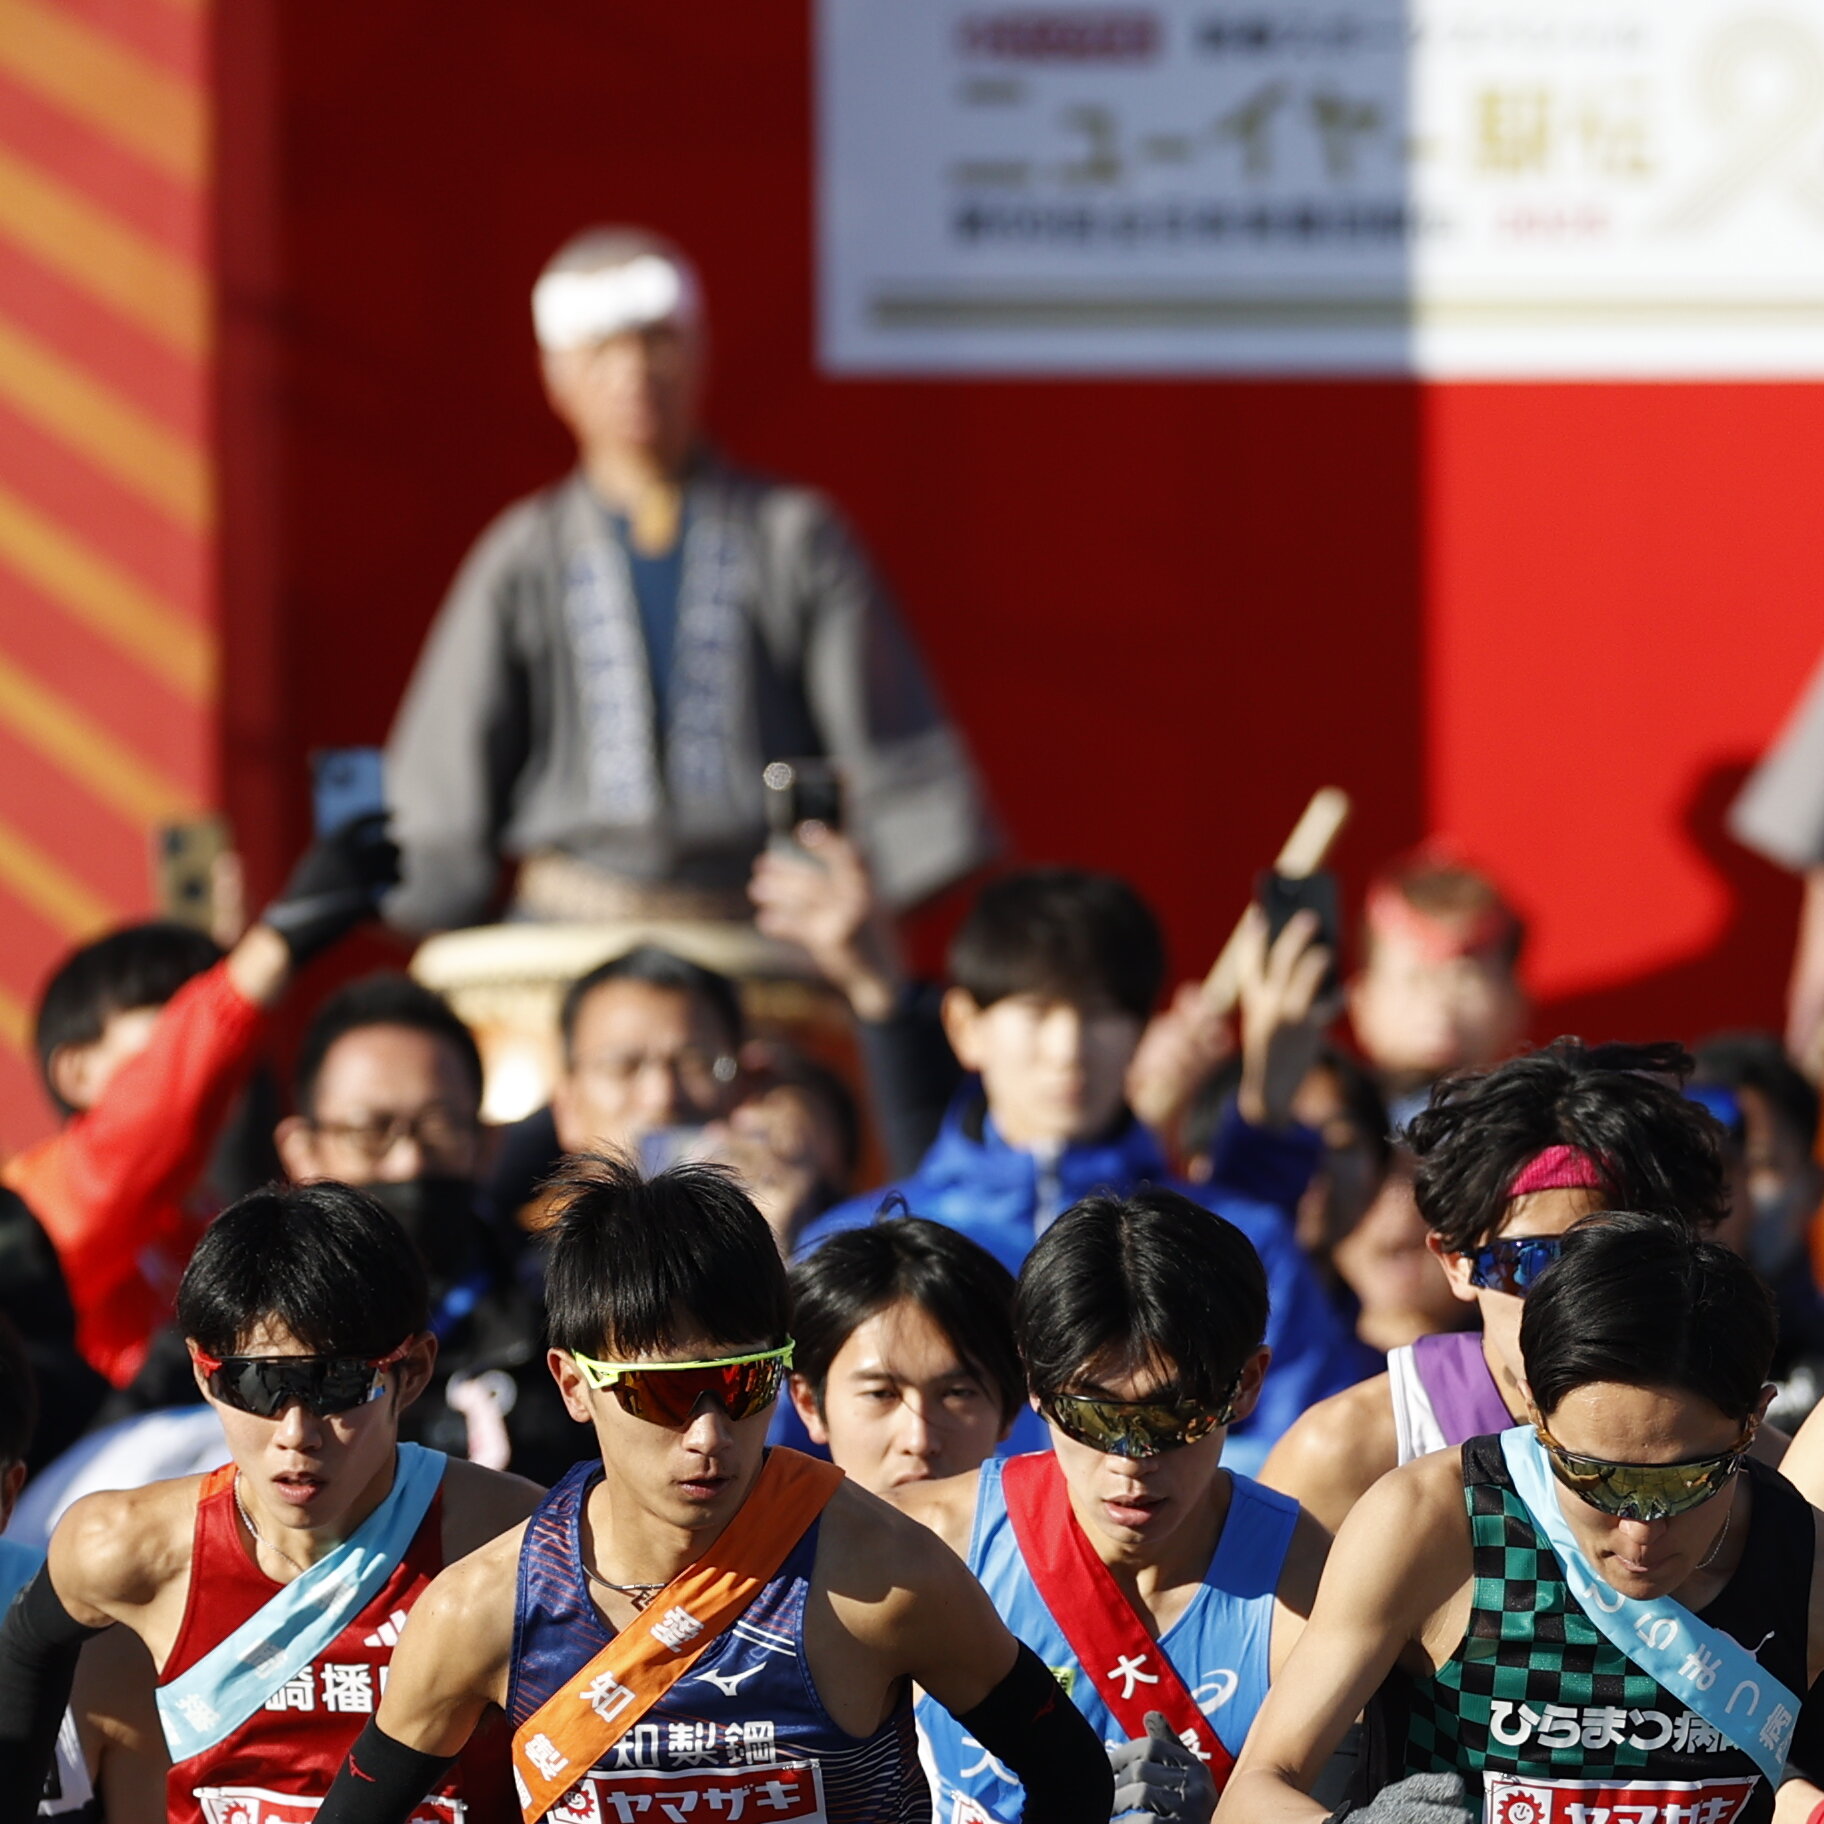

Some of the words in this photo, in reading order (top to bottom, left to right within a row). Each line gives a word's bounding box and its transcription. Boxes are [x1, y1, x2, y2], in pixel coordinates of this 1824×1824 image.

[264, 1662, 386, 1713] 崎播
[513, 1605, 705, 1809] 愛知製
[1583, 1576, 1793, 1763] ひらまつ病
[606, 1779, 802, 1824] ヤマザキ
